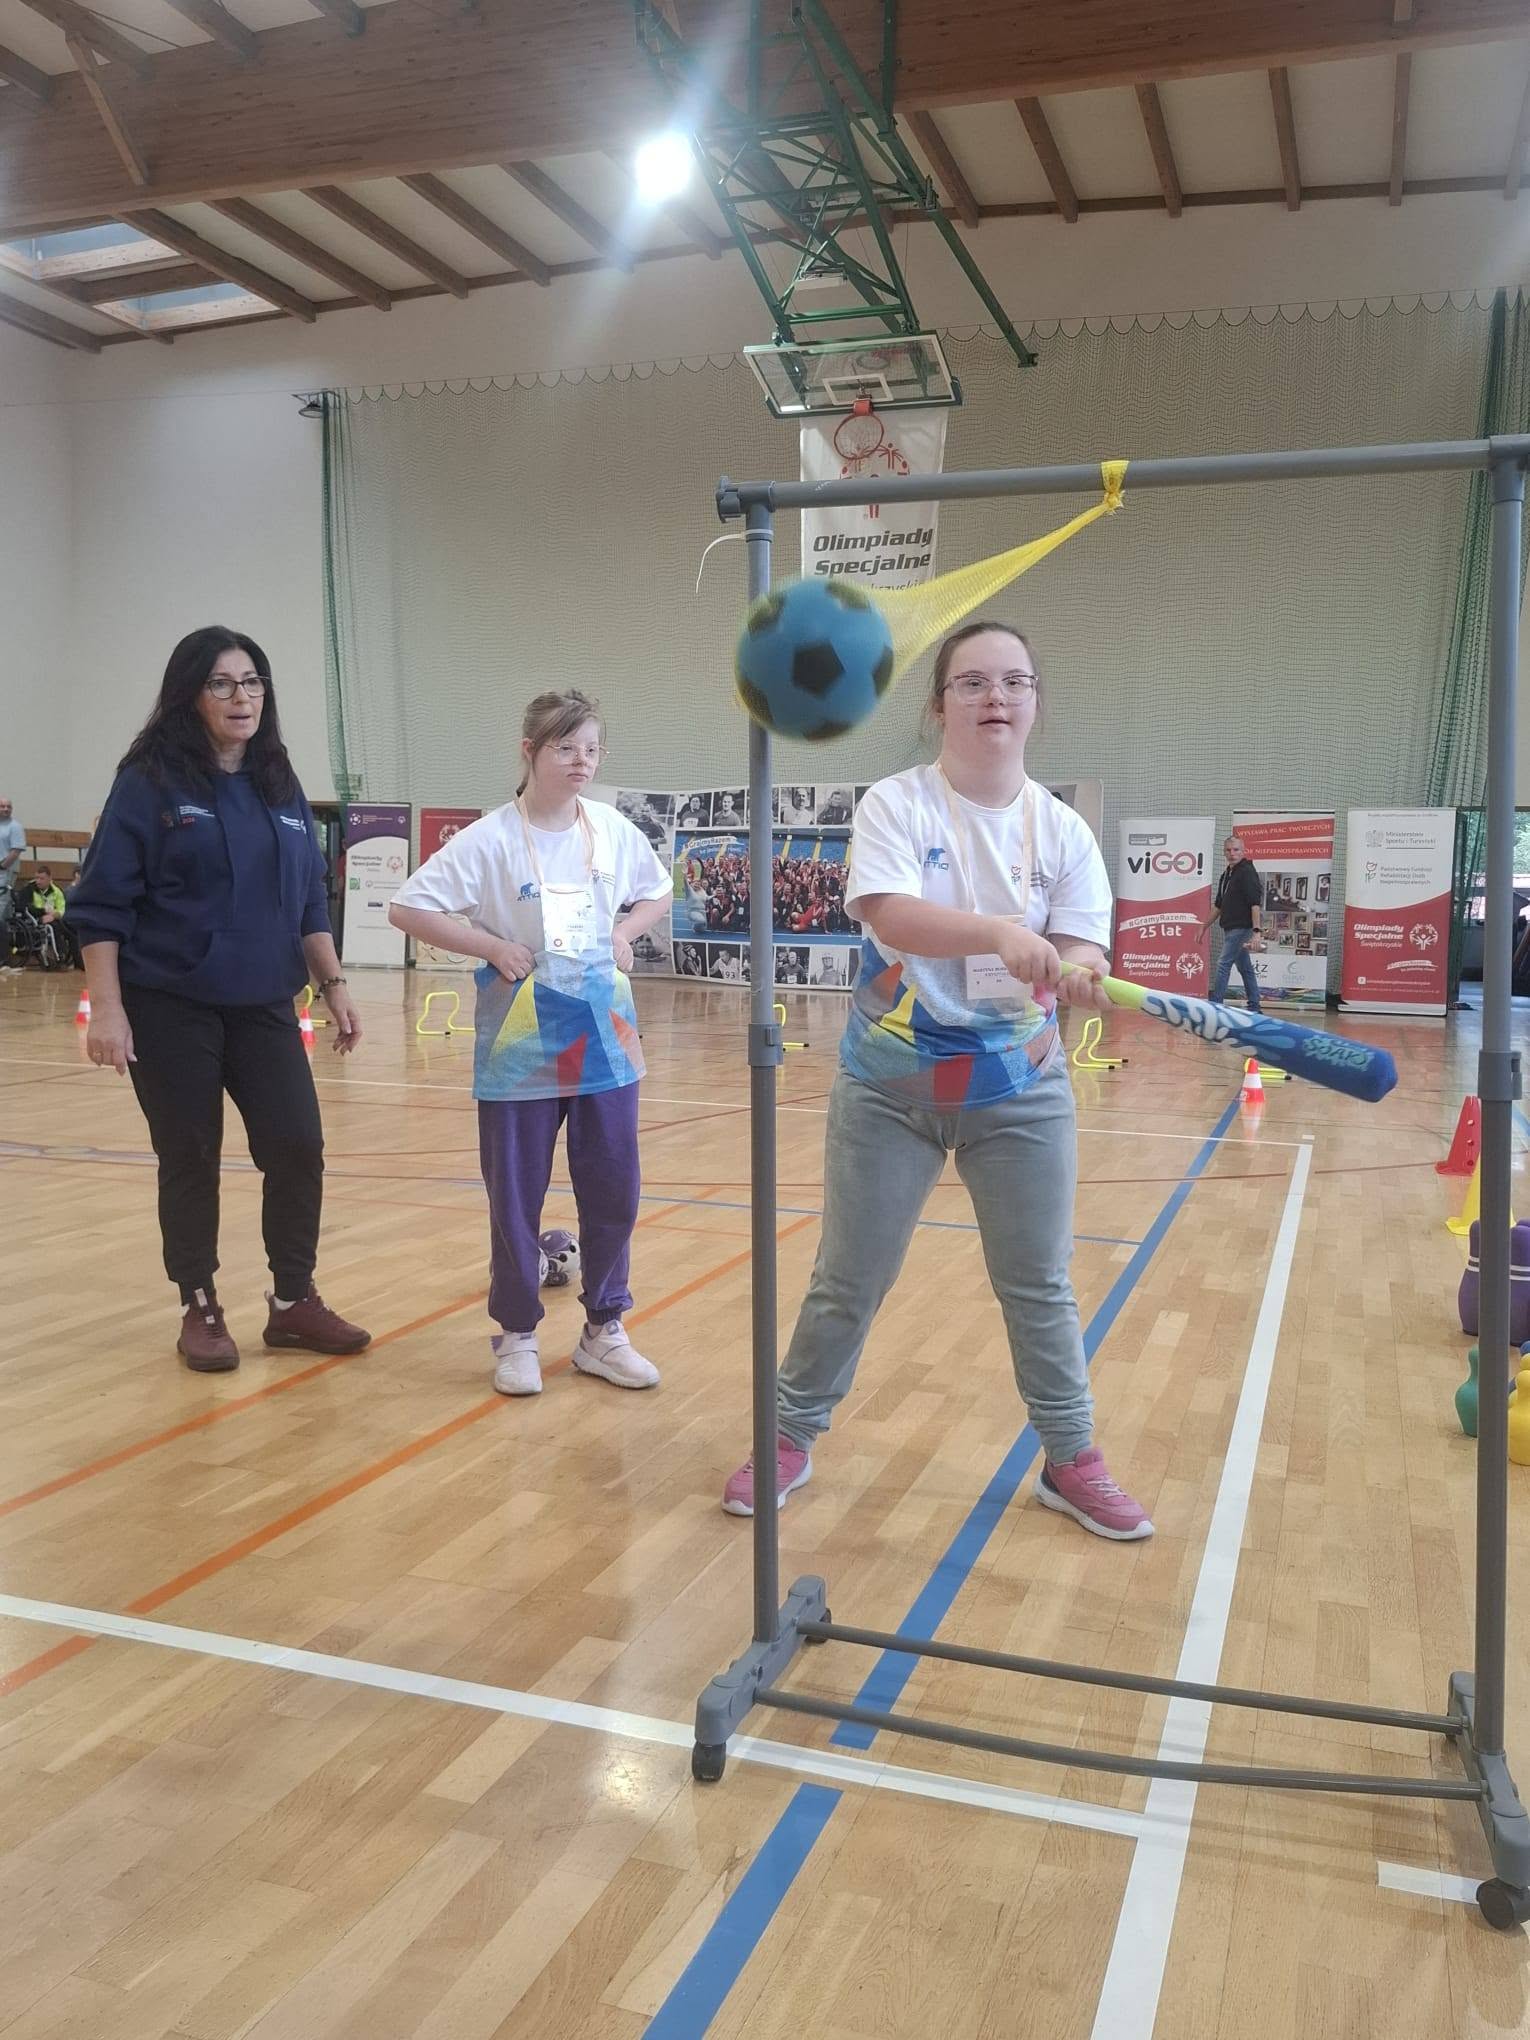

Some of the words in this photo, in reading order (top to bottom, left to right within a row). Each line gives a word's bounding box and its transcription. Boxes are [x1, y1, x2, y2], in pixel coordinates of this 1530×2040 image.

[813, 528, 933, 551] Olimpiady
[814, 553, 931, 576] Specjalne
[1127, 851, 1203, 875] viGO!
[1129, 914, 1187, 928] #GramyRazem
[1139, 926, 1157, 939] 25
[1161, 924, 1182, 937] lat
[1354, 923, 1404, 933] Olimpiady
[1354, 932, 1404, 940] Specjalne
[1122, 953, 1171, 962] Olimpiady
[1123, 961, 1170, 969] Specjalne
[725, 971, 735, 979] 93
